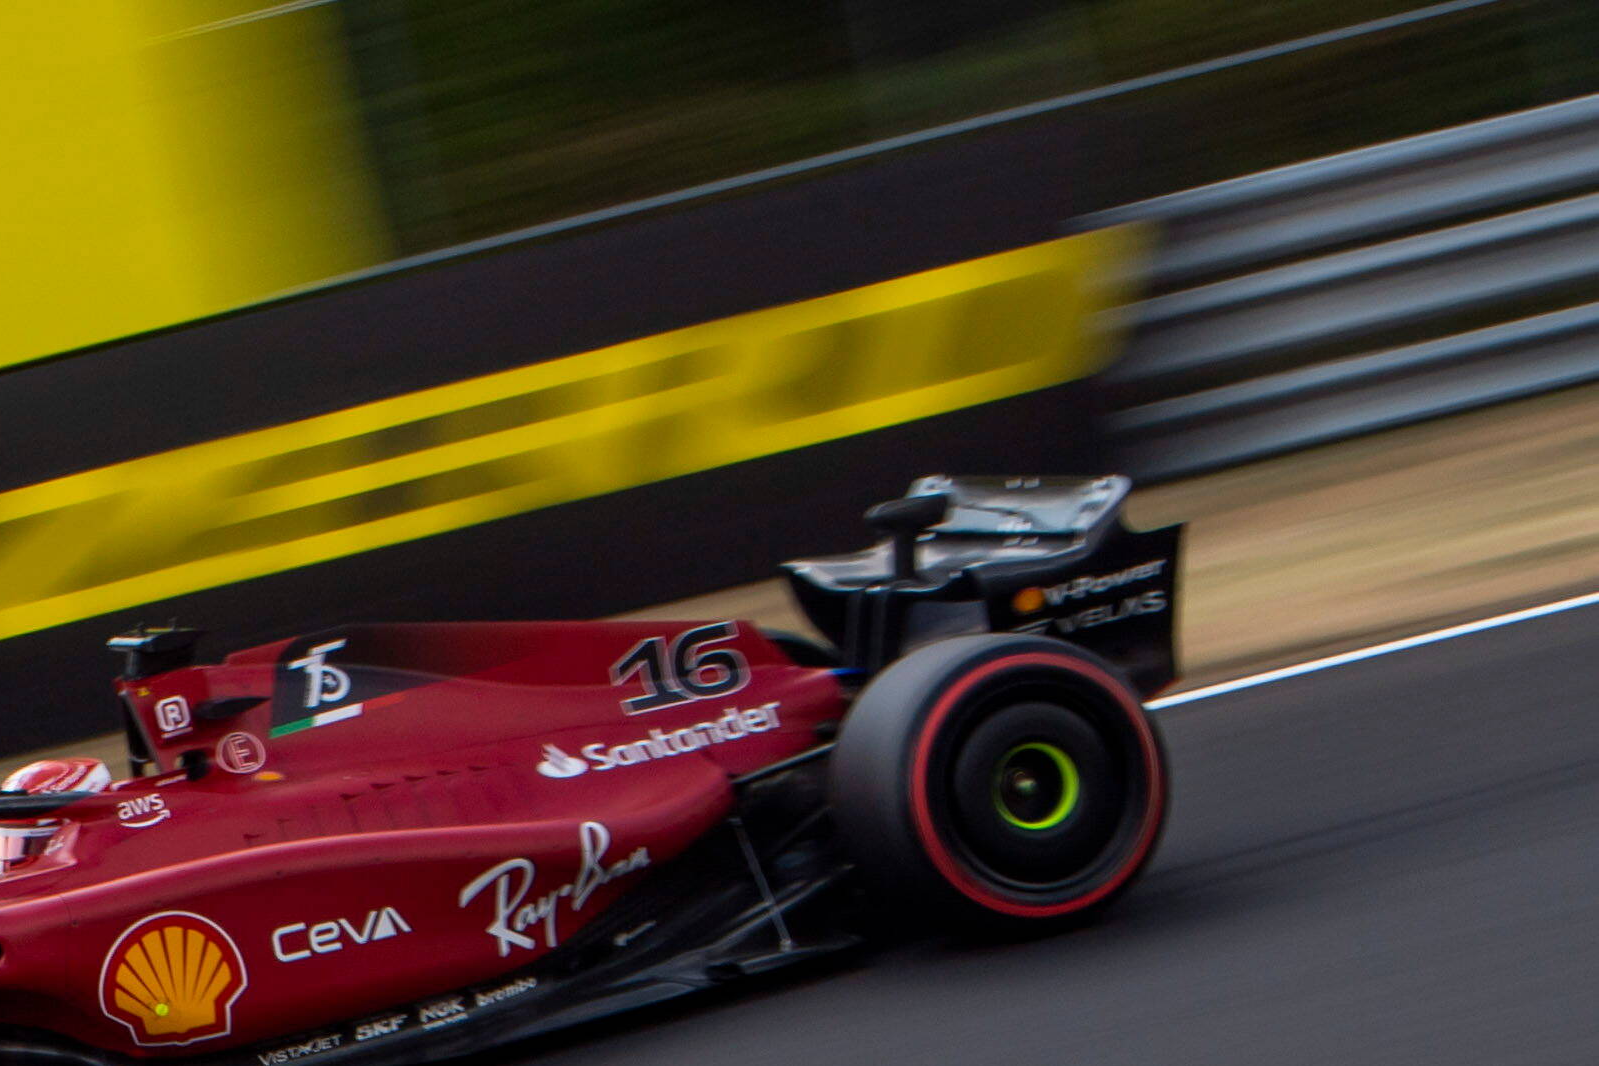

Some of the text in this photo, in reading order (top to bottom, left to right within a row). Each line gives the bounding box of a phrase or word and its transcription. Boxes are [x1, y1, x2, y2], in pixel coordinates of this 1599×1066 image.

[609, 620, 752, 717] 16
[580, 702, 781, 771] Santander
[117, 793, 166, 821] aws
[355, 1013, 409, 1041] SKF
